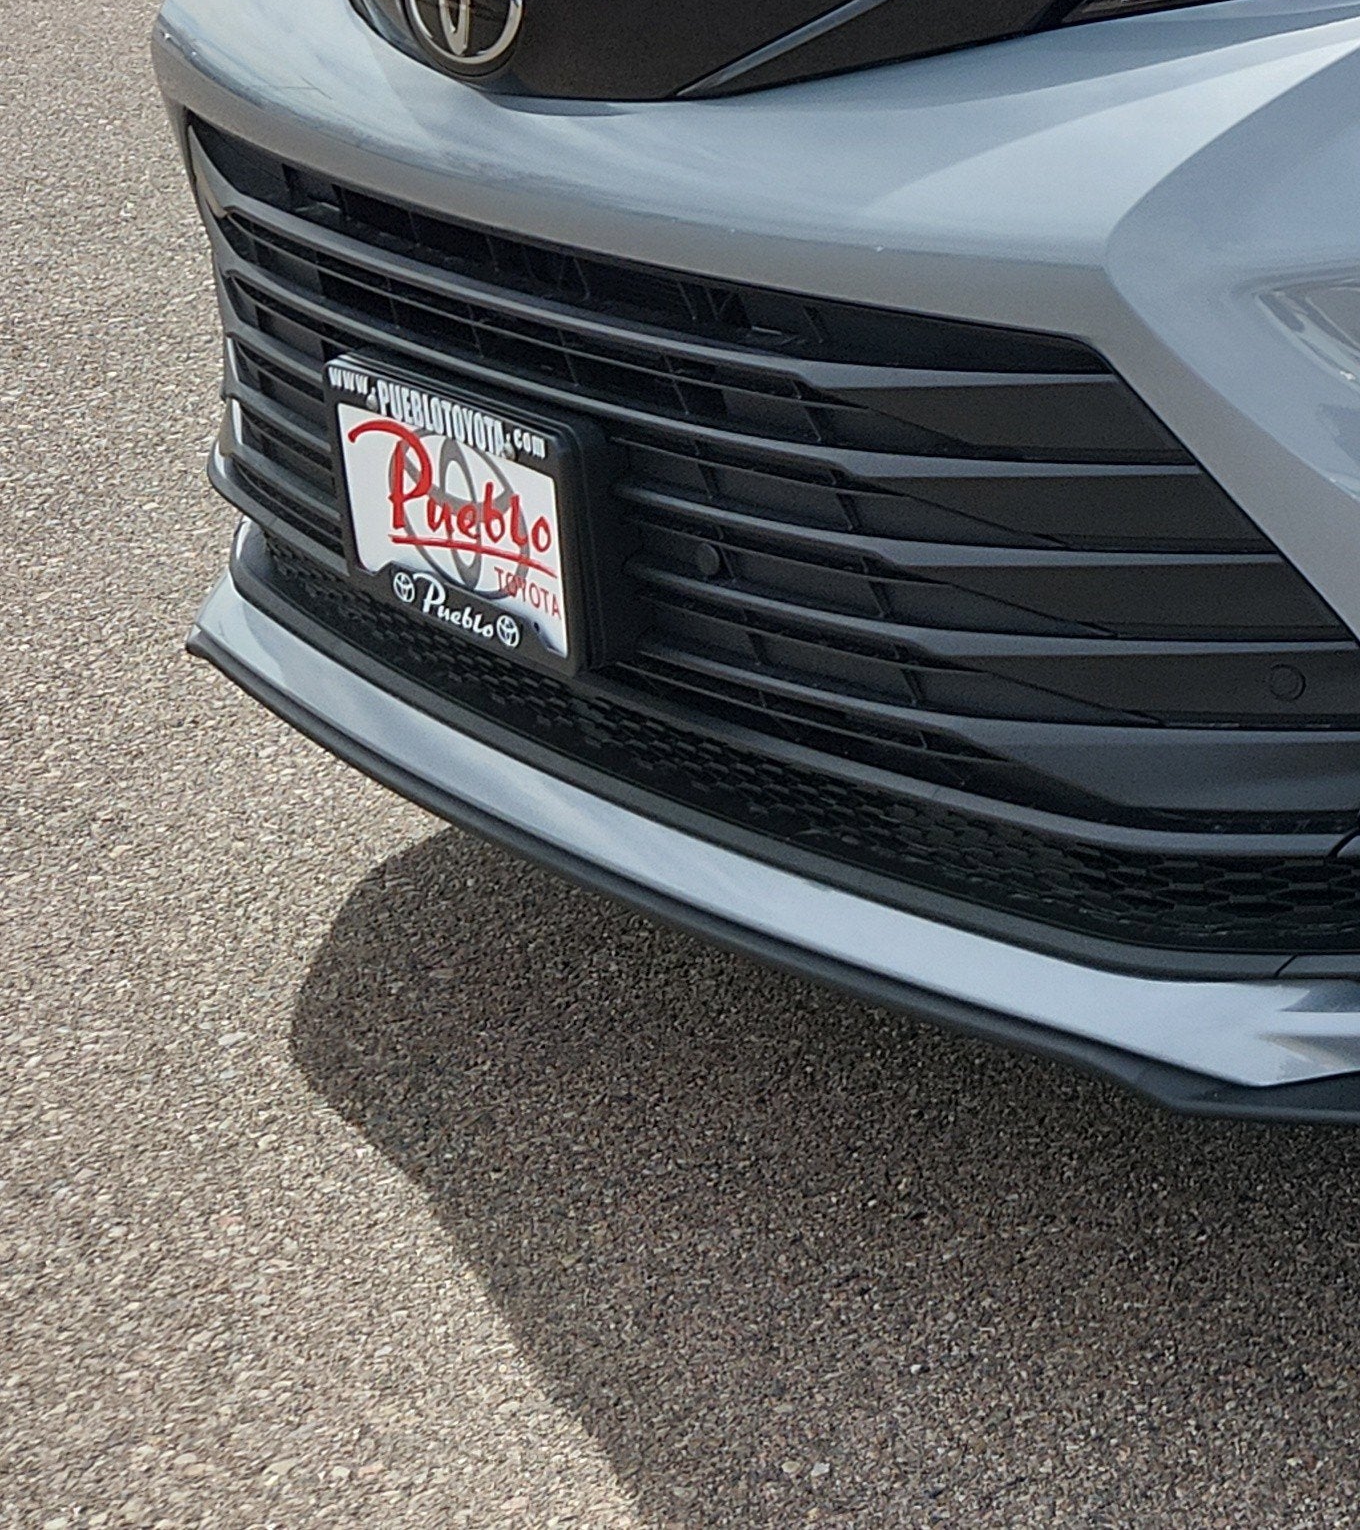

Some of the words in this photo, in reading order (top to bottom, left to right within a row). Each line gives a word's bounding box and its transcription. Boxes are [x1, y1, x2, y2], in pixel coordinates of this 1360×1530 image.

[348, 419, 552, 553] Pueblo
[414, 572, 494, 638] Pueblo
[494, 567, 561, 620] TOYOTA
